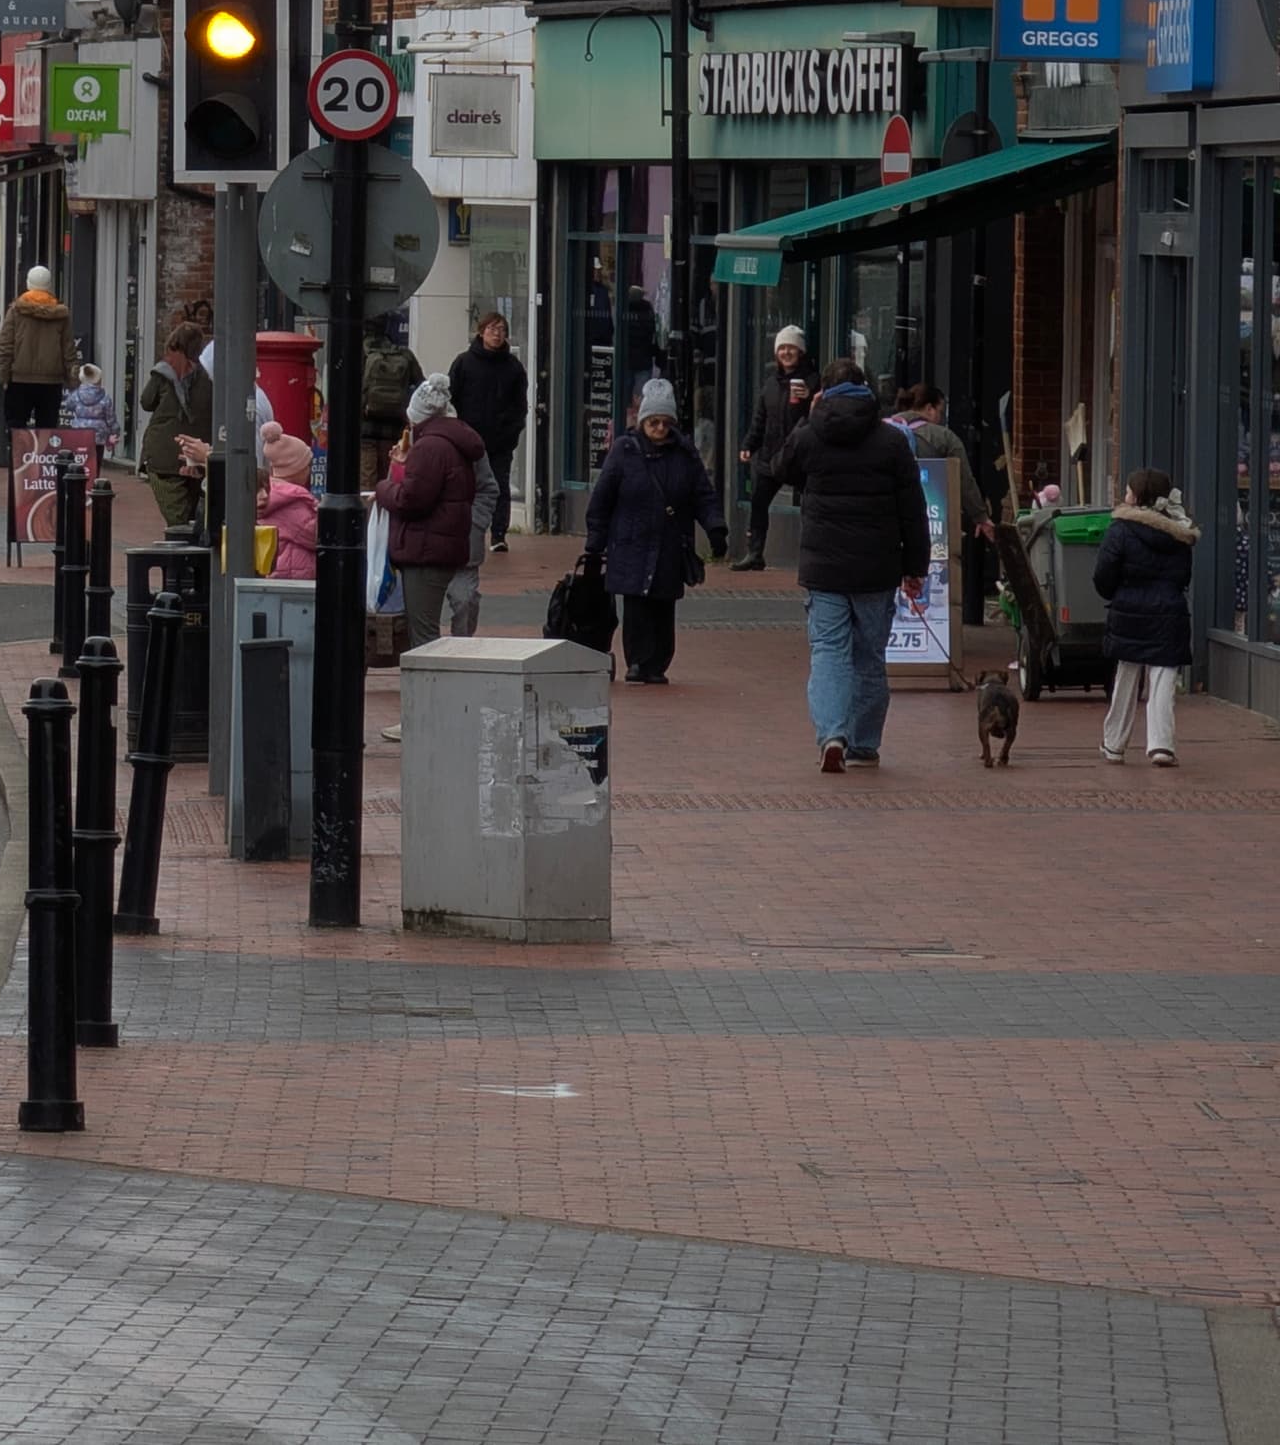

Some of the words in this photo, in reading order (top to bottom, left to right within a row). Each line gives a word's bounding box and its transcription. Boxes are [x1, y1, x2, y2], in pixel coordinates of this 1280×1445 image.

[8, 1, 17, 11] &
[1022, 30, 1099, 47] GREGGS
[699, 48, 821, 115] STARBUCKS
[322, 77, 385, 113] 20
[66, 110, 108, 122] OXFAM
[447, 109, 502, 125] claire's
[23, 479, 56, 490] Latte
